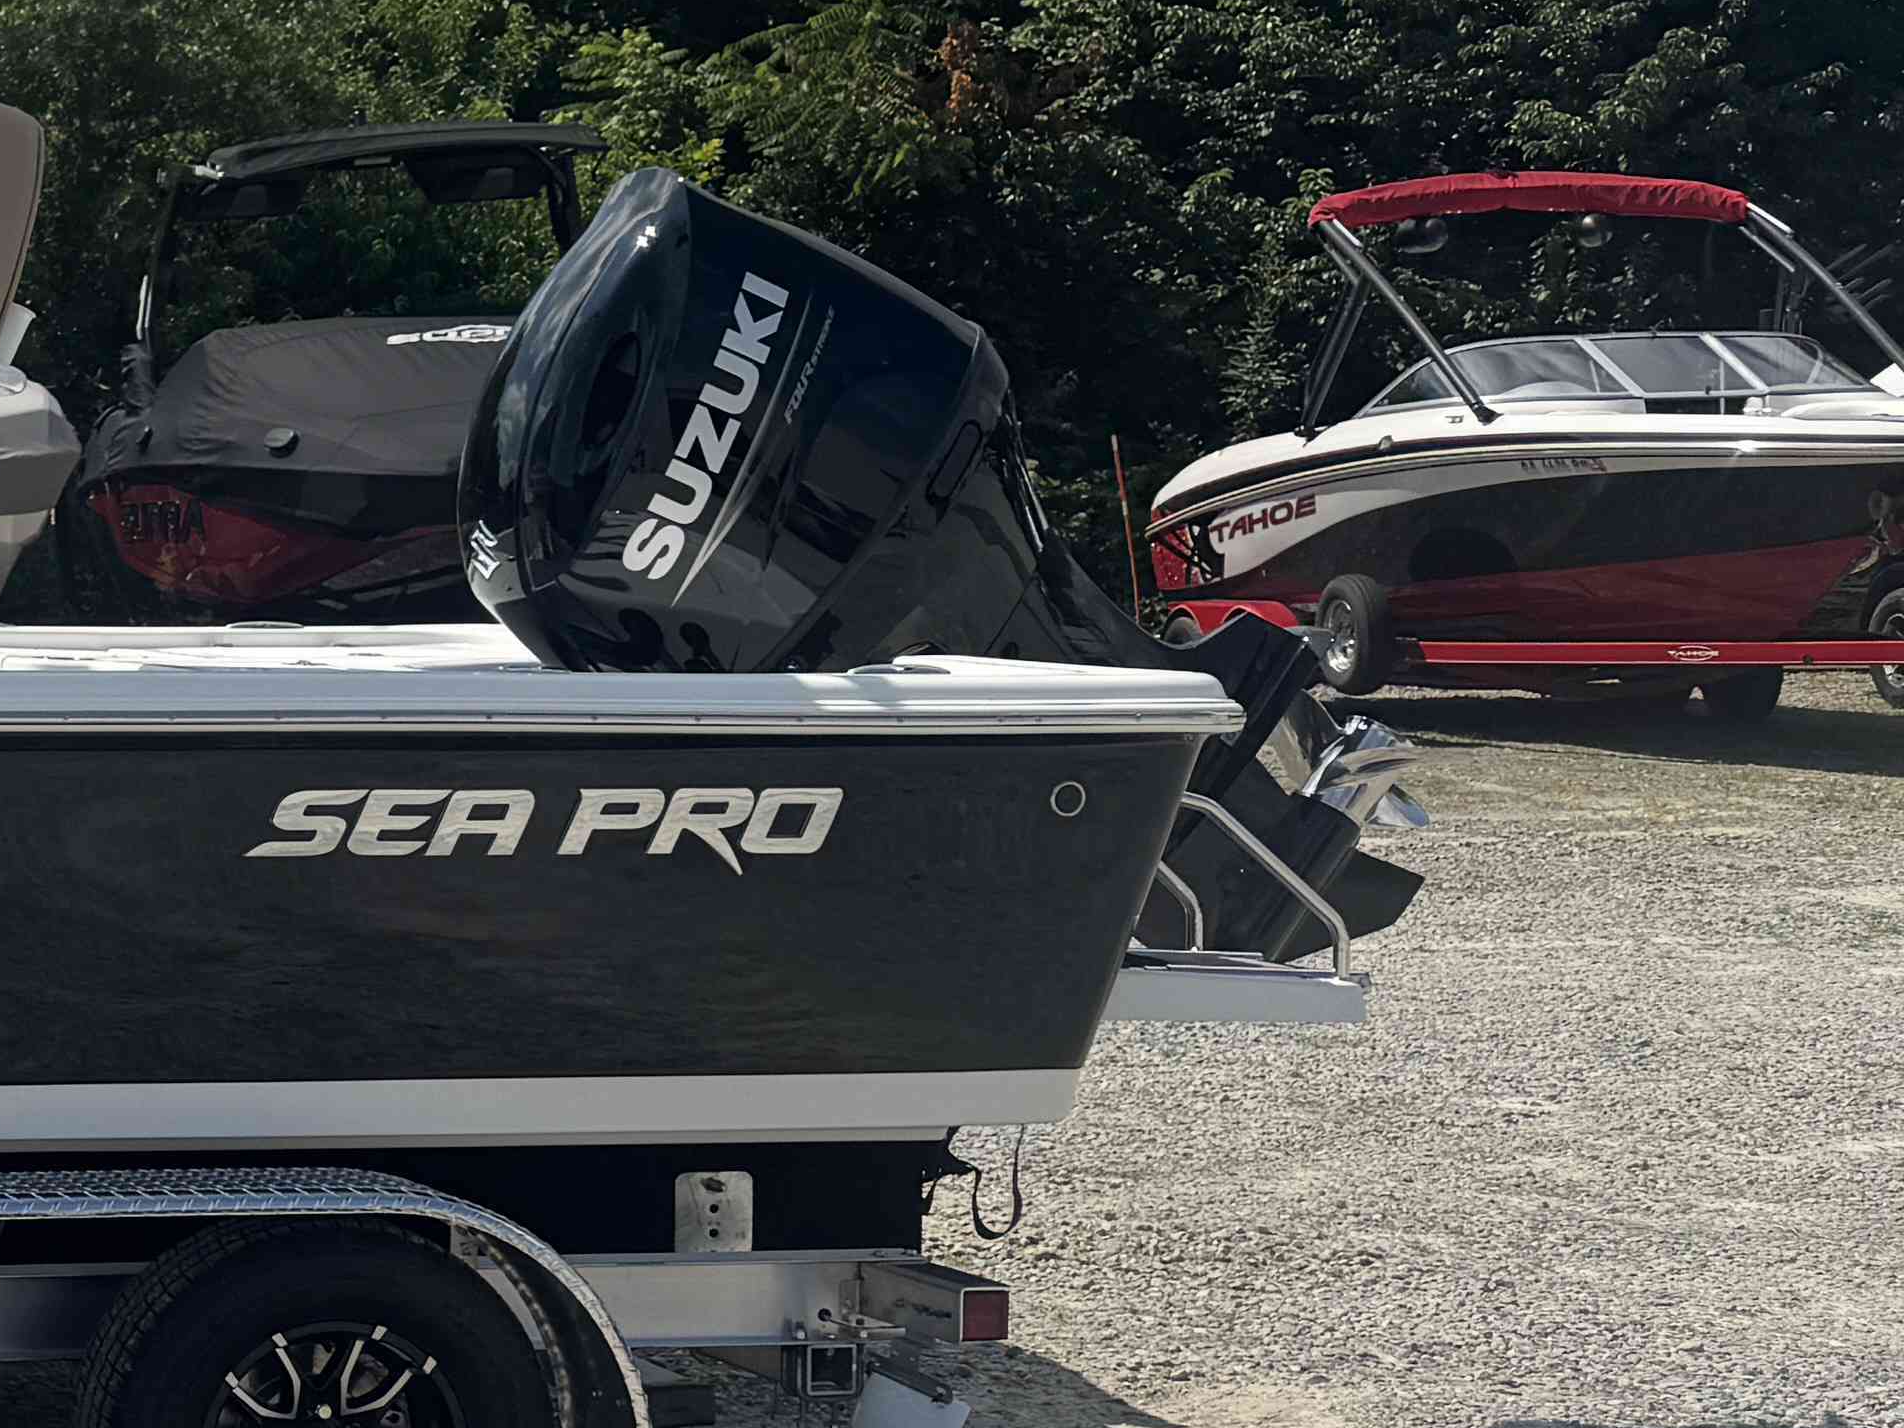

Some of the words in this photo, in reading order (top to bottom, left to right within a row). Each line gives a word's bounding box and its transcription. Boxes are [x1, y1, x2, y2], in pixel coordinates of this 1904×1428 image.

[622, 271, 790, 581] SUZUKI
[1208, 494, 1317, 543] TAHOE
[242, 788, 537, 857] SEA
[555, 786, 845, 876] PRO
